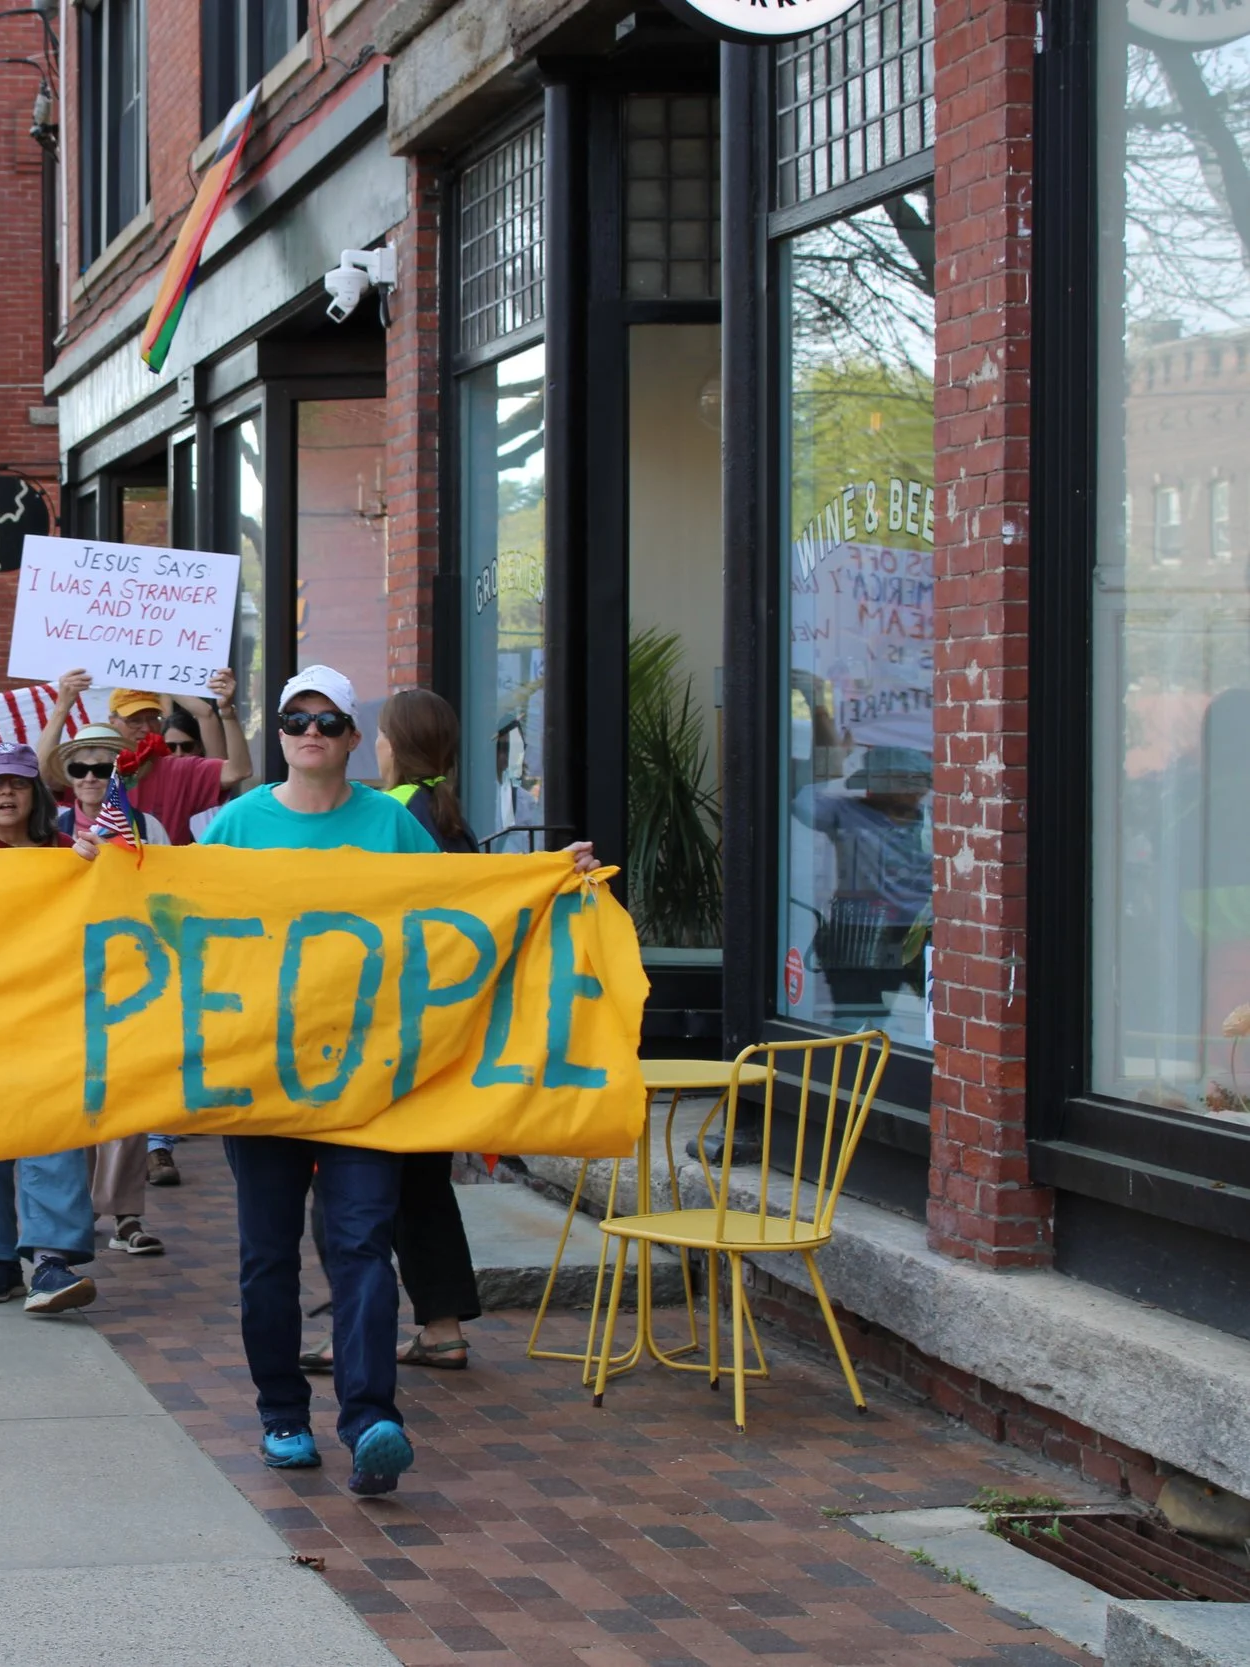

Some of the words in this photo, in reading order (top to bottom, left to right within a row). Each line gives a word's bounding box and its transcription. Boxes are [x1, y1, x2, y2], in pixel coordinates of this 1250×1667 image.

[797, 484, 856, 582] WINE
[863, 477, 879, 534] &
[74, 547, 142, 574] JESUS
[51, 570, 93, 596] WAS
[98, 580, 112, 598] A
[119, 578, 218, 605] STRANGER
[475, 550, 544, 615] GROCERIES
[87, 599, 131, 618] AND
[140, 602, 175, 621] YOU
[44, 616, 163, 647] WELCOMED
[107, 658, 163, 680] MATT
[82, 892, 609, 1122] PEOPLE
